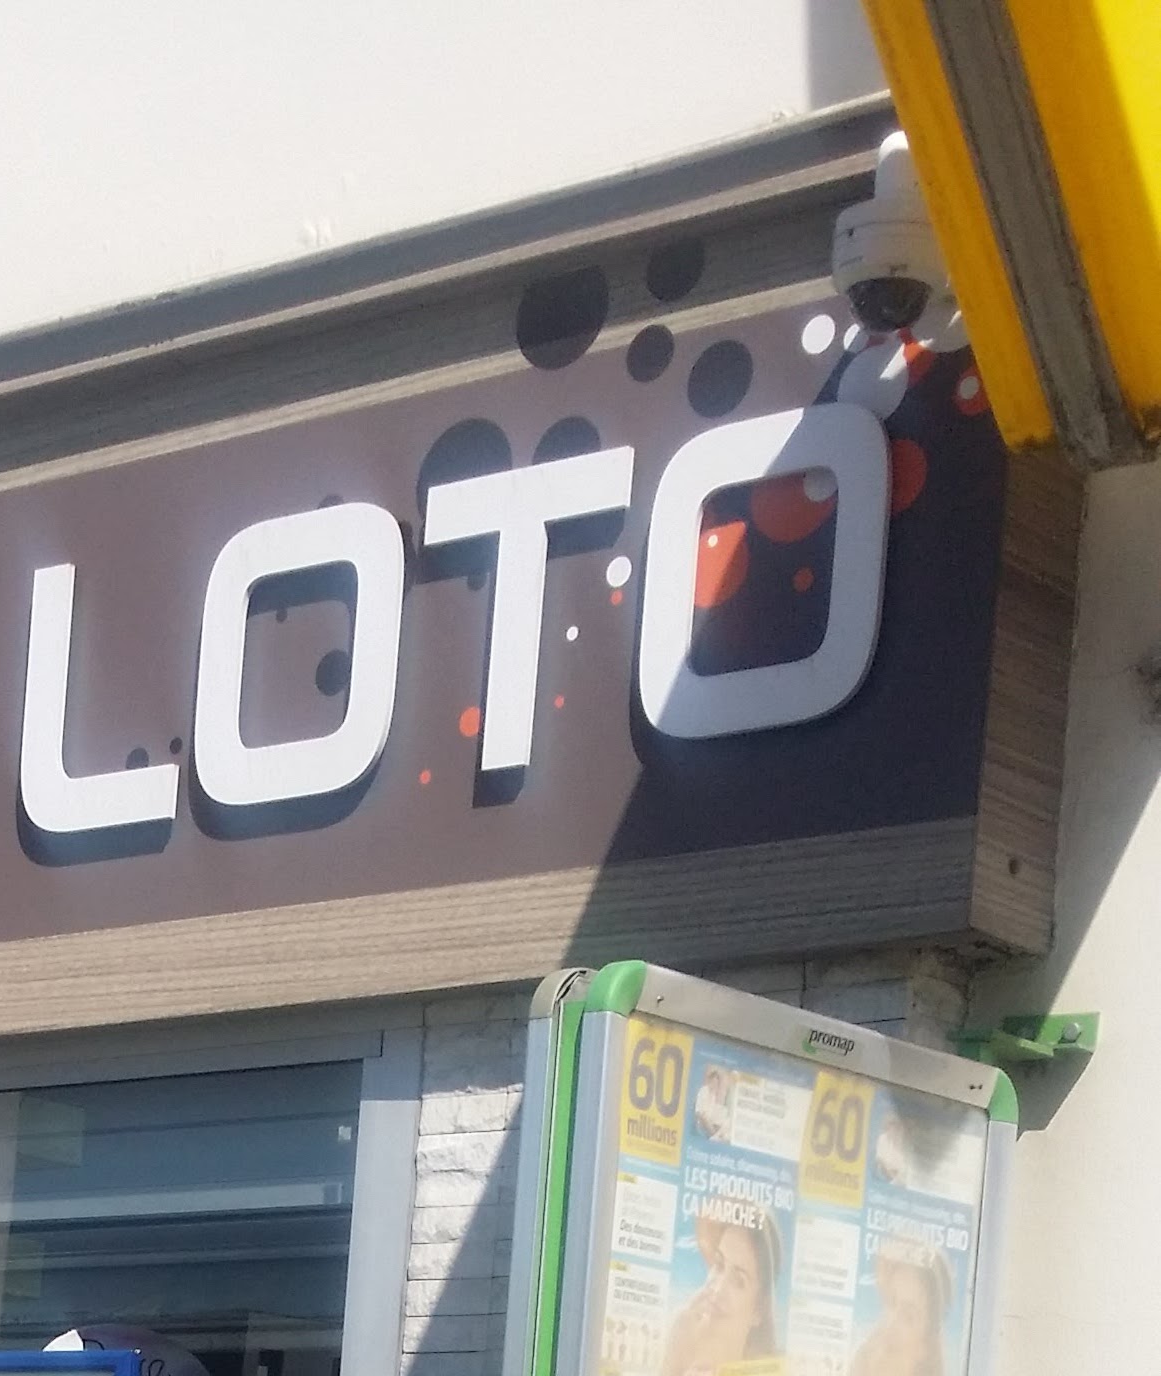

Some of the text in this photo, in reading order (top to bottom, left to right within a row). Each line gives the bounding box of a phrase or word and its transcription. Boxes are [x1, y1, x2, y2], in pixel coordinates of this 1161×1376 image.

[20, 403, 891, 834] LOTO
[808, 1028, 857, 1055] promap
[628, 1036, 684, 1118] 60
[626, 1116, 679, 1147] millions
[810, 1088, 865, 1163] 60
[684, 1166, 707, 1191] LES
[708, 1169, 773, 1207] PRODUITS
[774, 1185, 795, 1211] BIO
[699, 1194, 755, 1228] MARCHE
[946, 1224, 969, 1251] BIO
